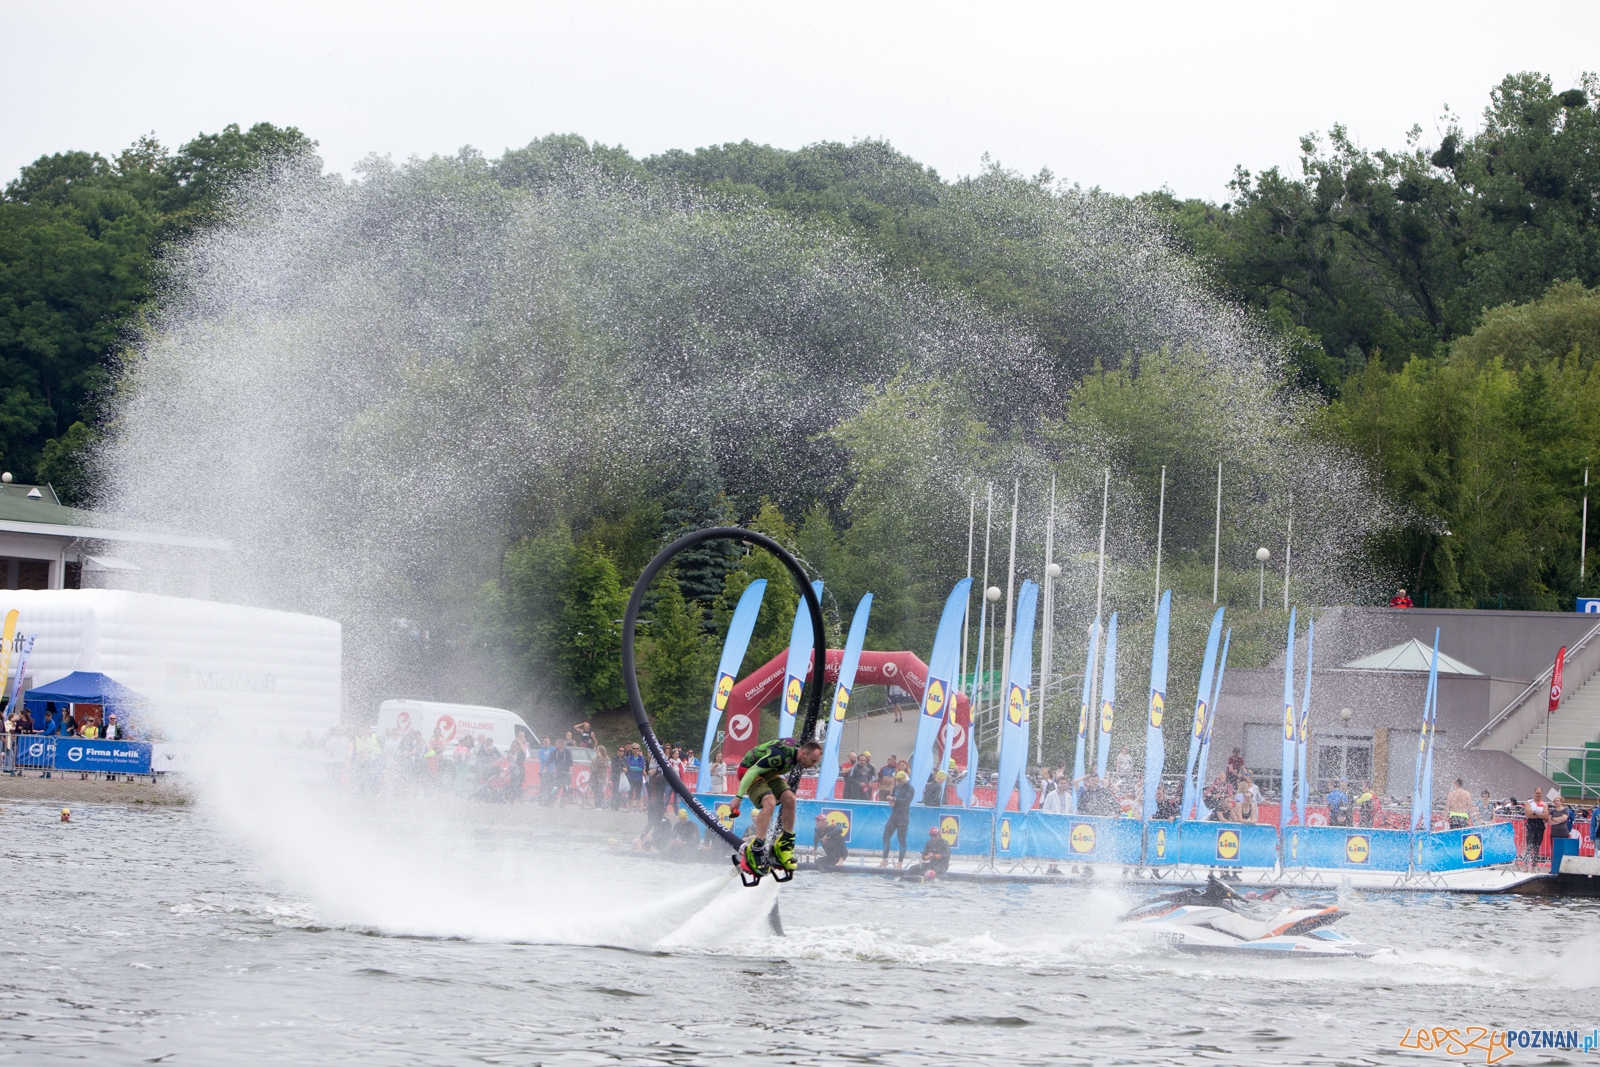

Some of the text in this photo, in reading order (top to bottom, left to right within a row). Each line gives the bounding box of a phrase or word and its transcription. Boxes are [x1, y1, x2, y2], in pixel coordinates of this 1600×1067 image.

[196, 670, 276, 693] Microsoft
[457, 720, 495, 731] CHALLENGE
[85, 747, 111, 757] Firma
[113, 749, 139, 758] Karlik
